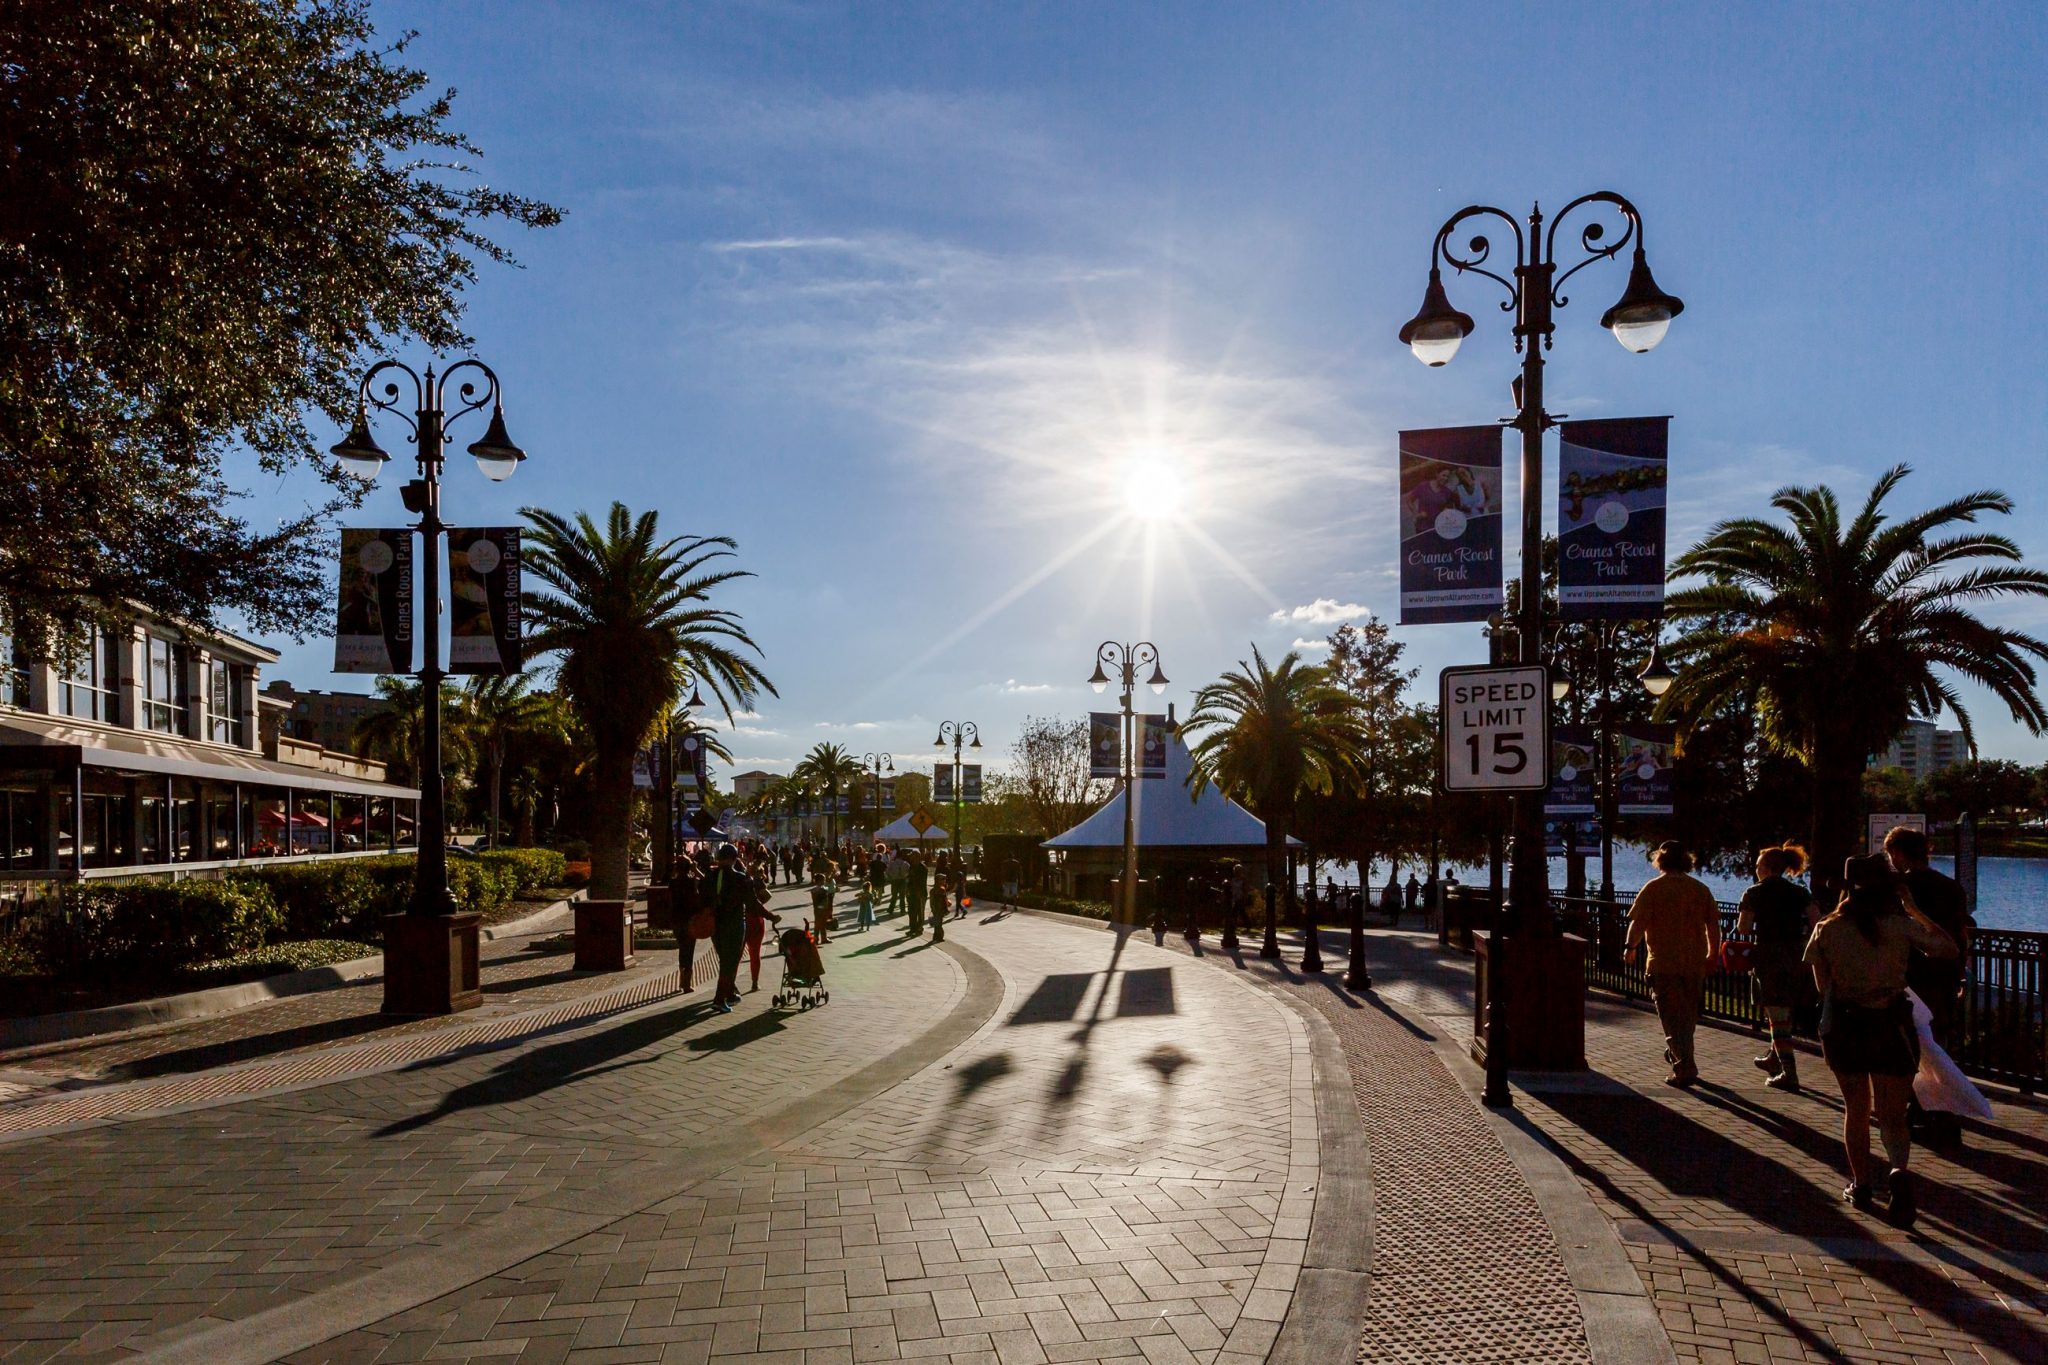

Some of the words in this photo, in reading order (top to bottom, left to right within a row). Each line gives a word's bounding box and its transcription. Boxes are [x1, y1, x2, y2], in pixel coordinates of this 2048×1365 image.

[395, 532, 411, 562] Park
[504, 530, 518, 560] Park
[1408, 549, 1453, 566] Cranes
[1454, 546, 1494, 563] Roost
[1566, 543, 1613, 560] Cranes
[1615, 541, 1656, 558] Roost
[395, 565, 411, 598] Roost
[504, 562, 518, 598] Roost
[1433, 563, 1468, 582] Park
[1593, 558, 1630, 577] Park
[395, 602, 411, 642] Cranes
[504, 601, 518, 641] Cranes
[1455, 683, 1536, 704] SPEED
[1463, 708, 1526, 728] LIMIT
[1466, 733, 1528, 775] 15
